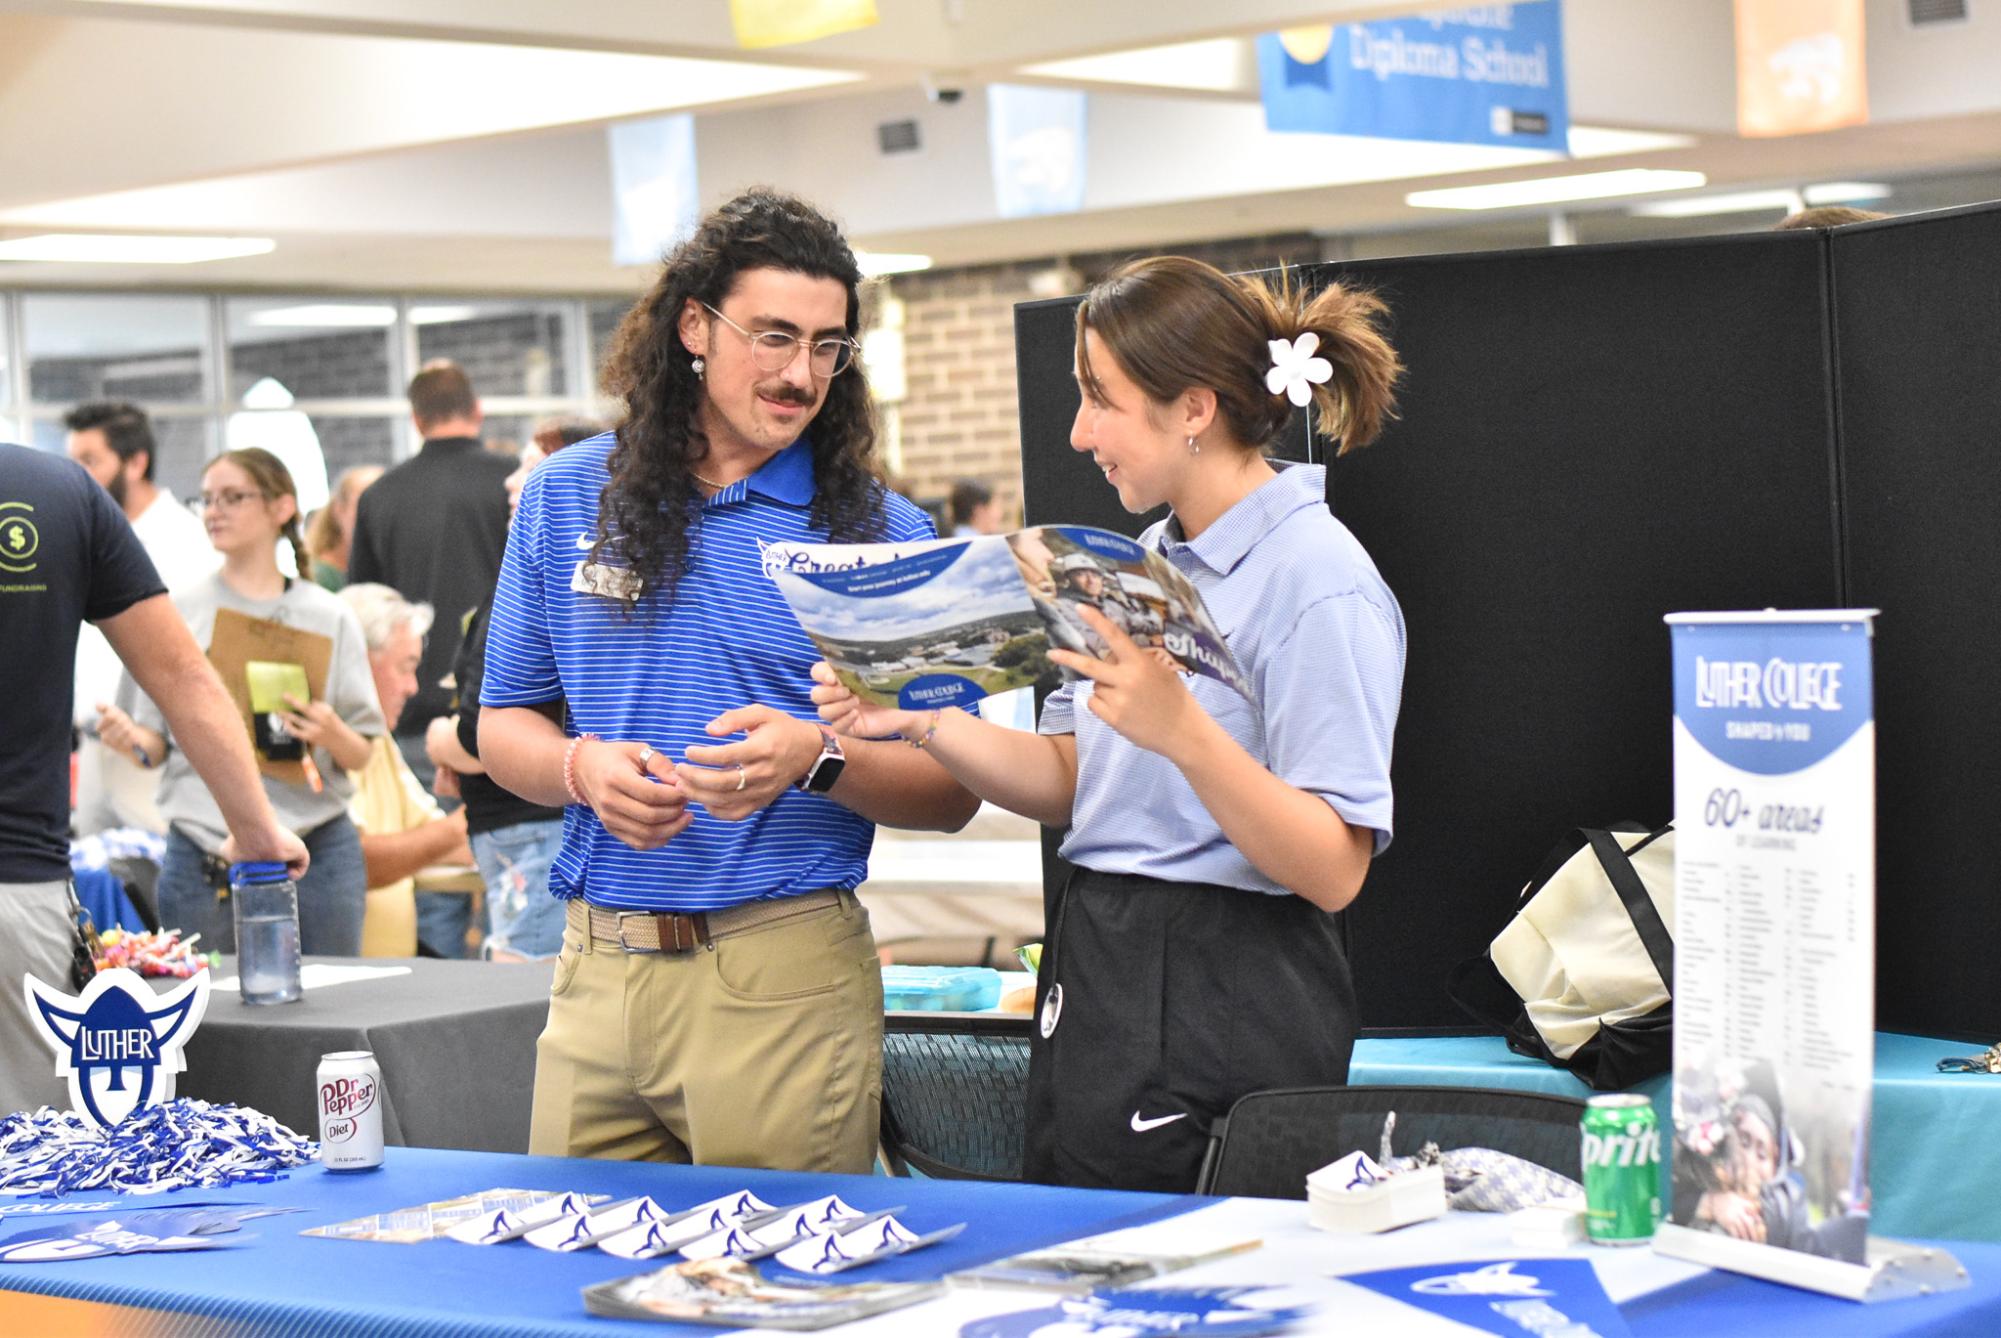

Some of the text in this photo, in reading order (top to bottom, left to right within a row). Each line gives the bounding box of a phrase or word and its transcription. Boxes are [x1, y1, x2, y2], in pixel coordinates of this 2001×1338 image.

[1349, 23, 1549, 88] Diploma School
[1704, 788, 1751, 828] 60+
[81, 1025, 155, 1061] LUTHER
[320, 1083, 373, 1116] Pepper
[335, 1079, 359, 1098] Dr
[329, 1124, 349, 1139] Diet
[1580, 1120, 1661, 1173] prit
